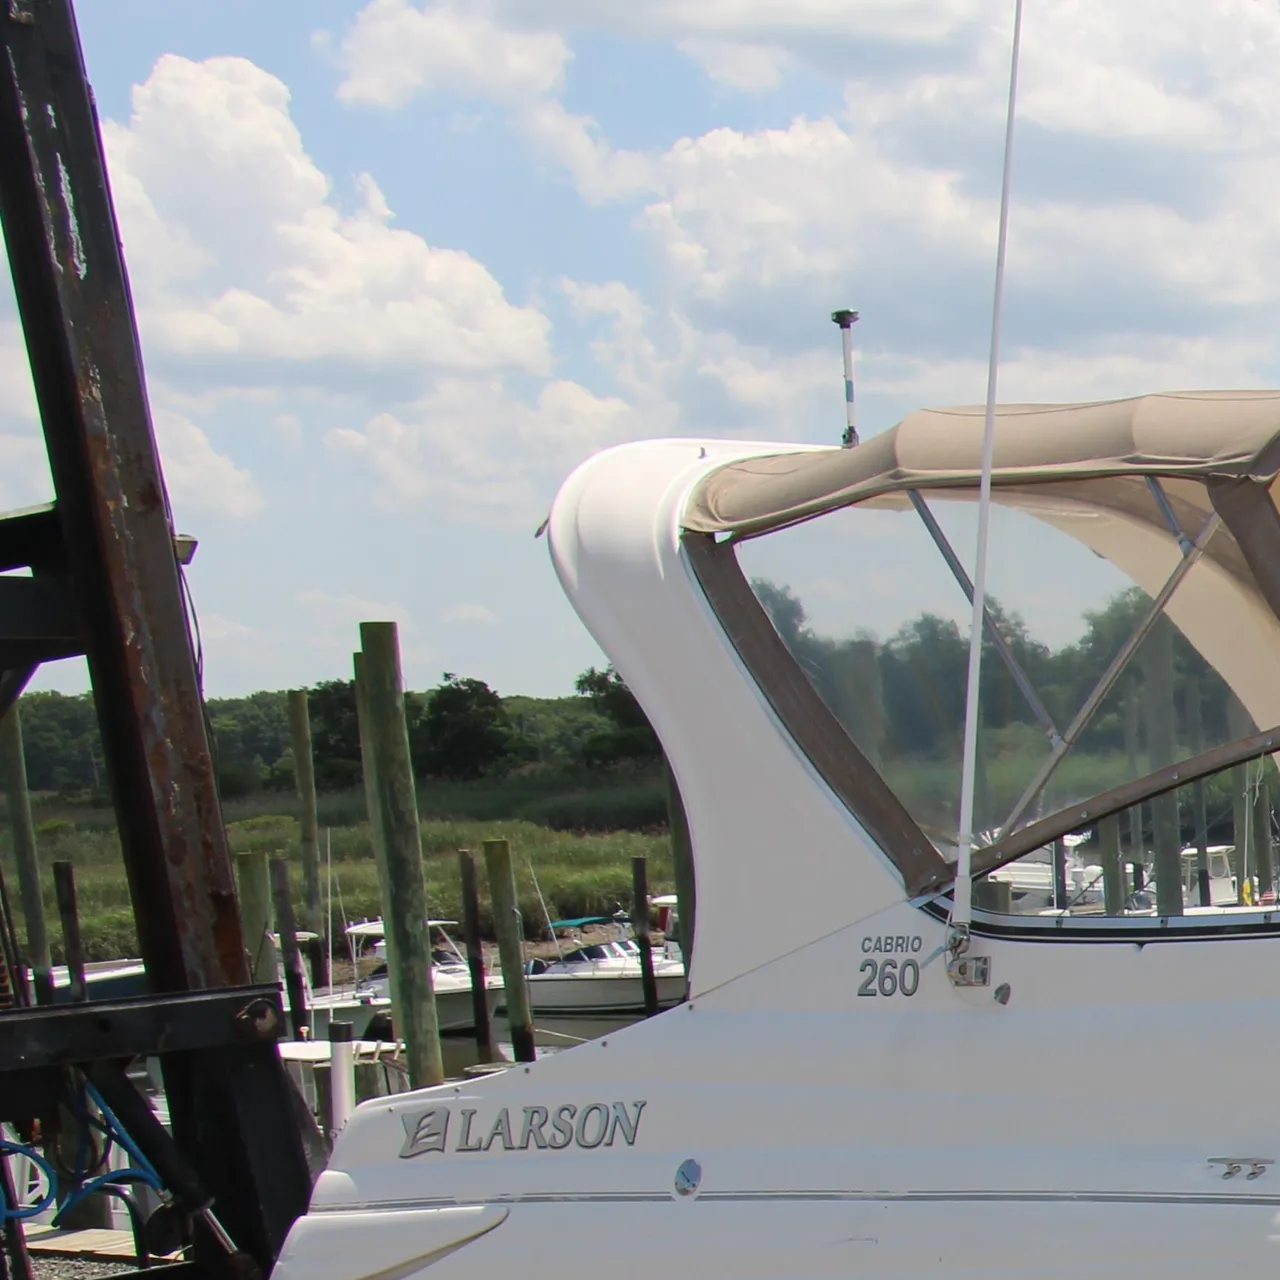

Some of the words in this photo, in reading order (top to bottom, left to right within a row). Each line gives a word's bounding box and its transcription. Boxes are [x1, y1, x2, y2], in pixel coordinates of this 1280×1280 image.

[861, 935, 922, 953] CABRIO
[857, 958, 920, 997] 260
[455, 1100, 647, 1152] LARSON
